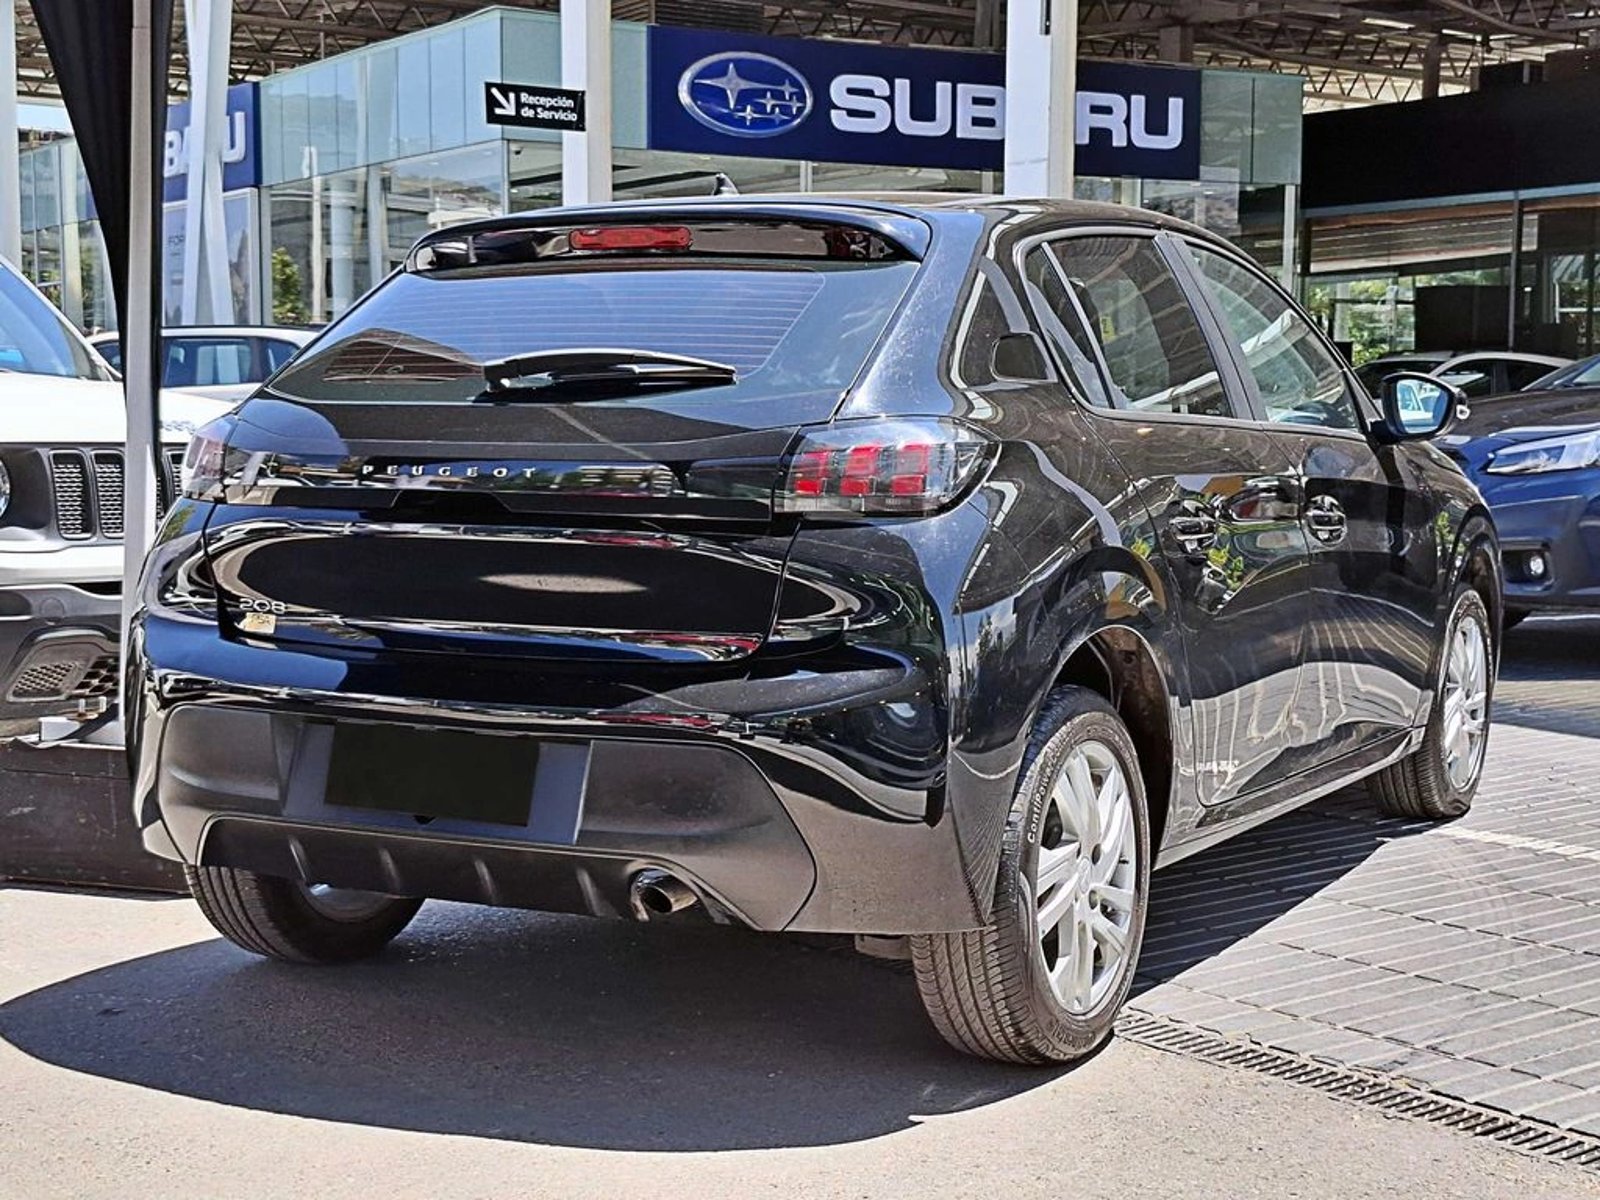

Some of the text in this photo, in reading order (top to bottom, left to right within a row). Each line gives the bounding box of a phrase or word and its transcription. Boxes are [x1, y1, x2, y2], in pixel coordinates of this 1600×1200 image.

[520, 92, 574, 108] Recepción
[520, 106, 577, 121] de Servicio
[829, 73, 1184, 150] SUBRU
[361, 464, 537, 479] PEUGEOT
[239, 598, 286, 614] 208
